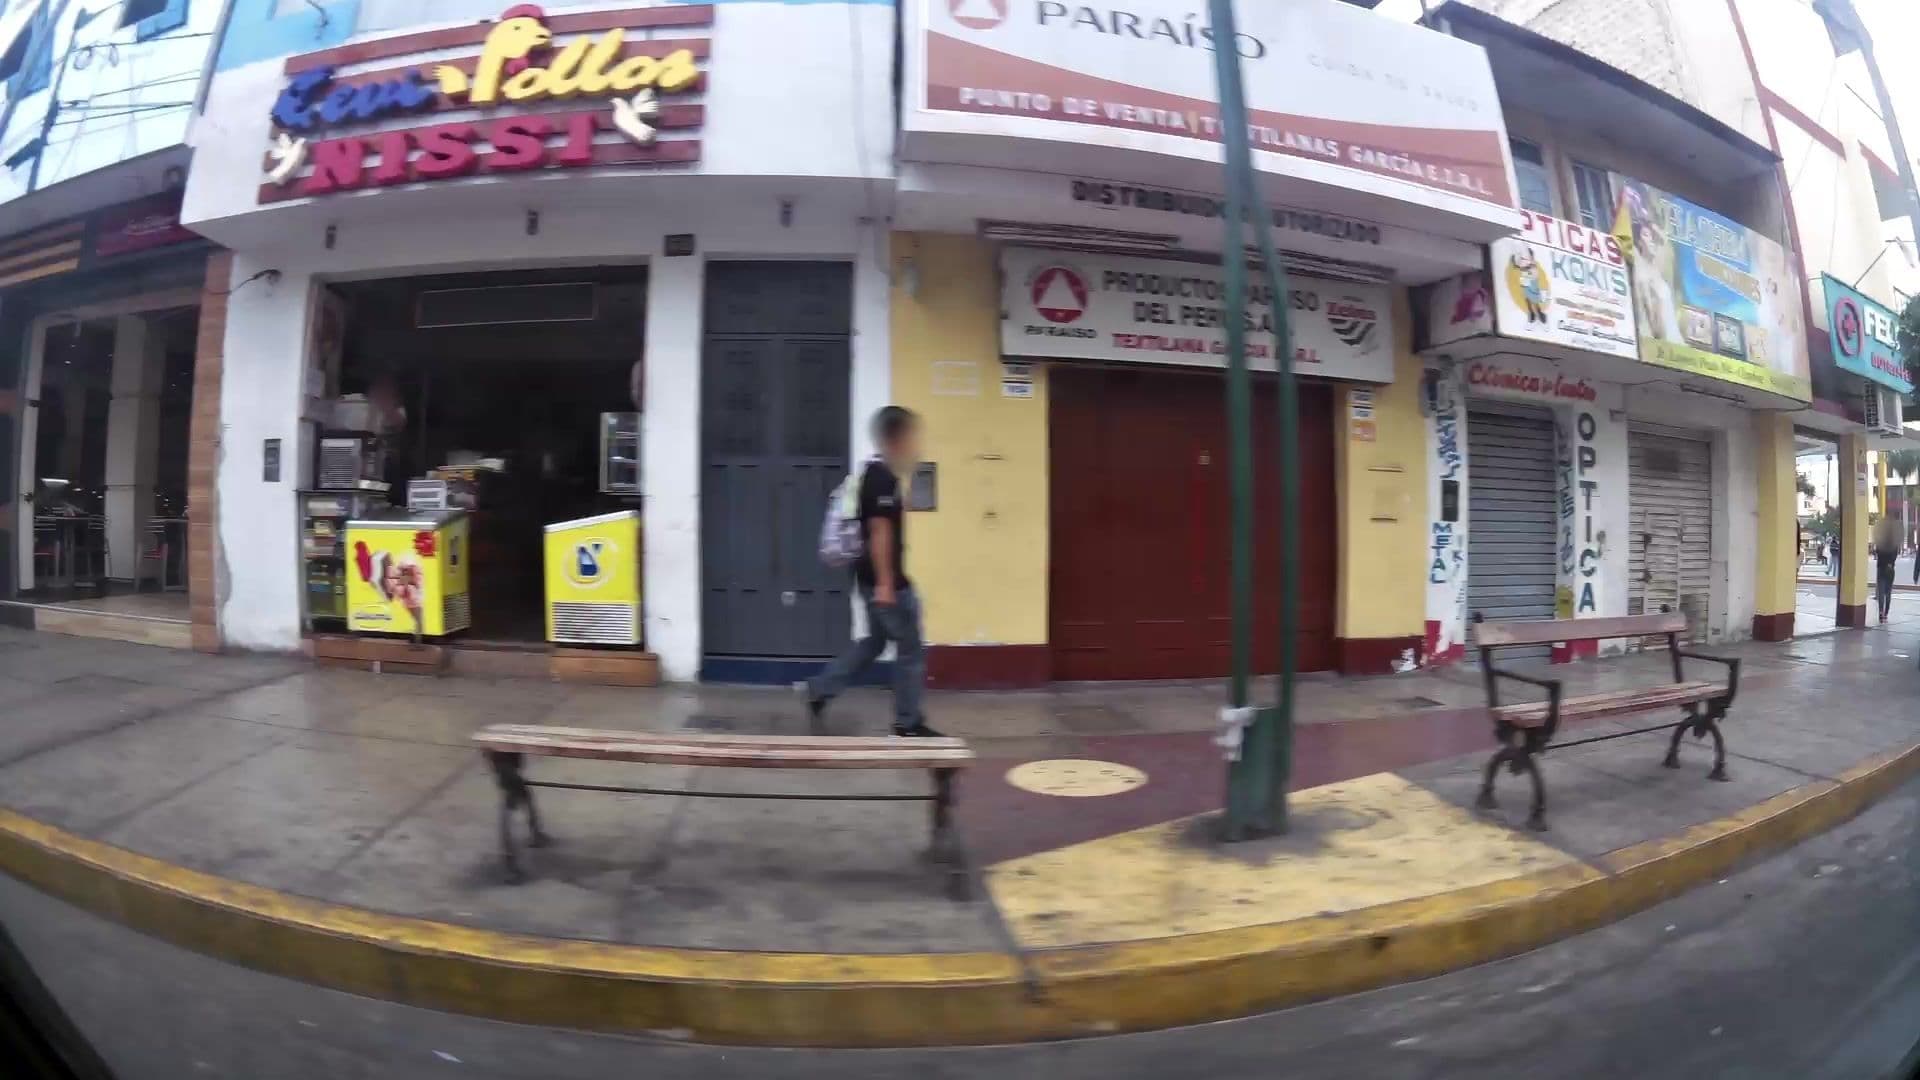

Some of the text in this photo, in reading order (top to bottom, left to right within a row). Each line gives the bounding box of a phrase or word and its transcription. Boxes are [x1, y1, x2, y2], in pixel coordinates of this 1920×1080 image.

[958, 86, 1052, 112] PUNTO
[1062, 96, 1099, 117] DE
[1102, 102, 1187, 129] VENTA
[303, 113, 599, 194] NISSI
[1551, 250, 1628, 297] KOKIS
[1133, 301, 1175, 326] DEL
[1577, 411, 1598, 614] OPTICA
[1430, 522, 1453, 584] METAL
